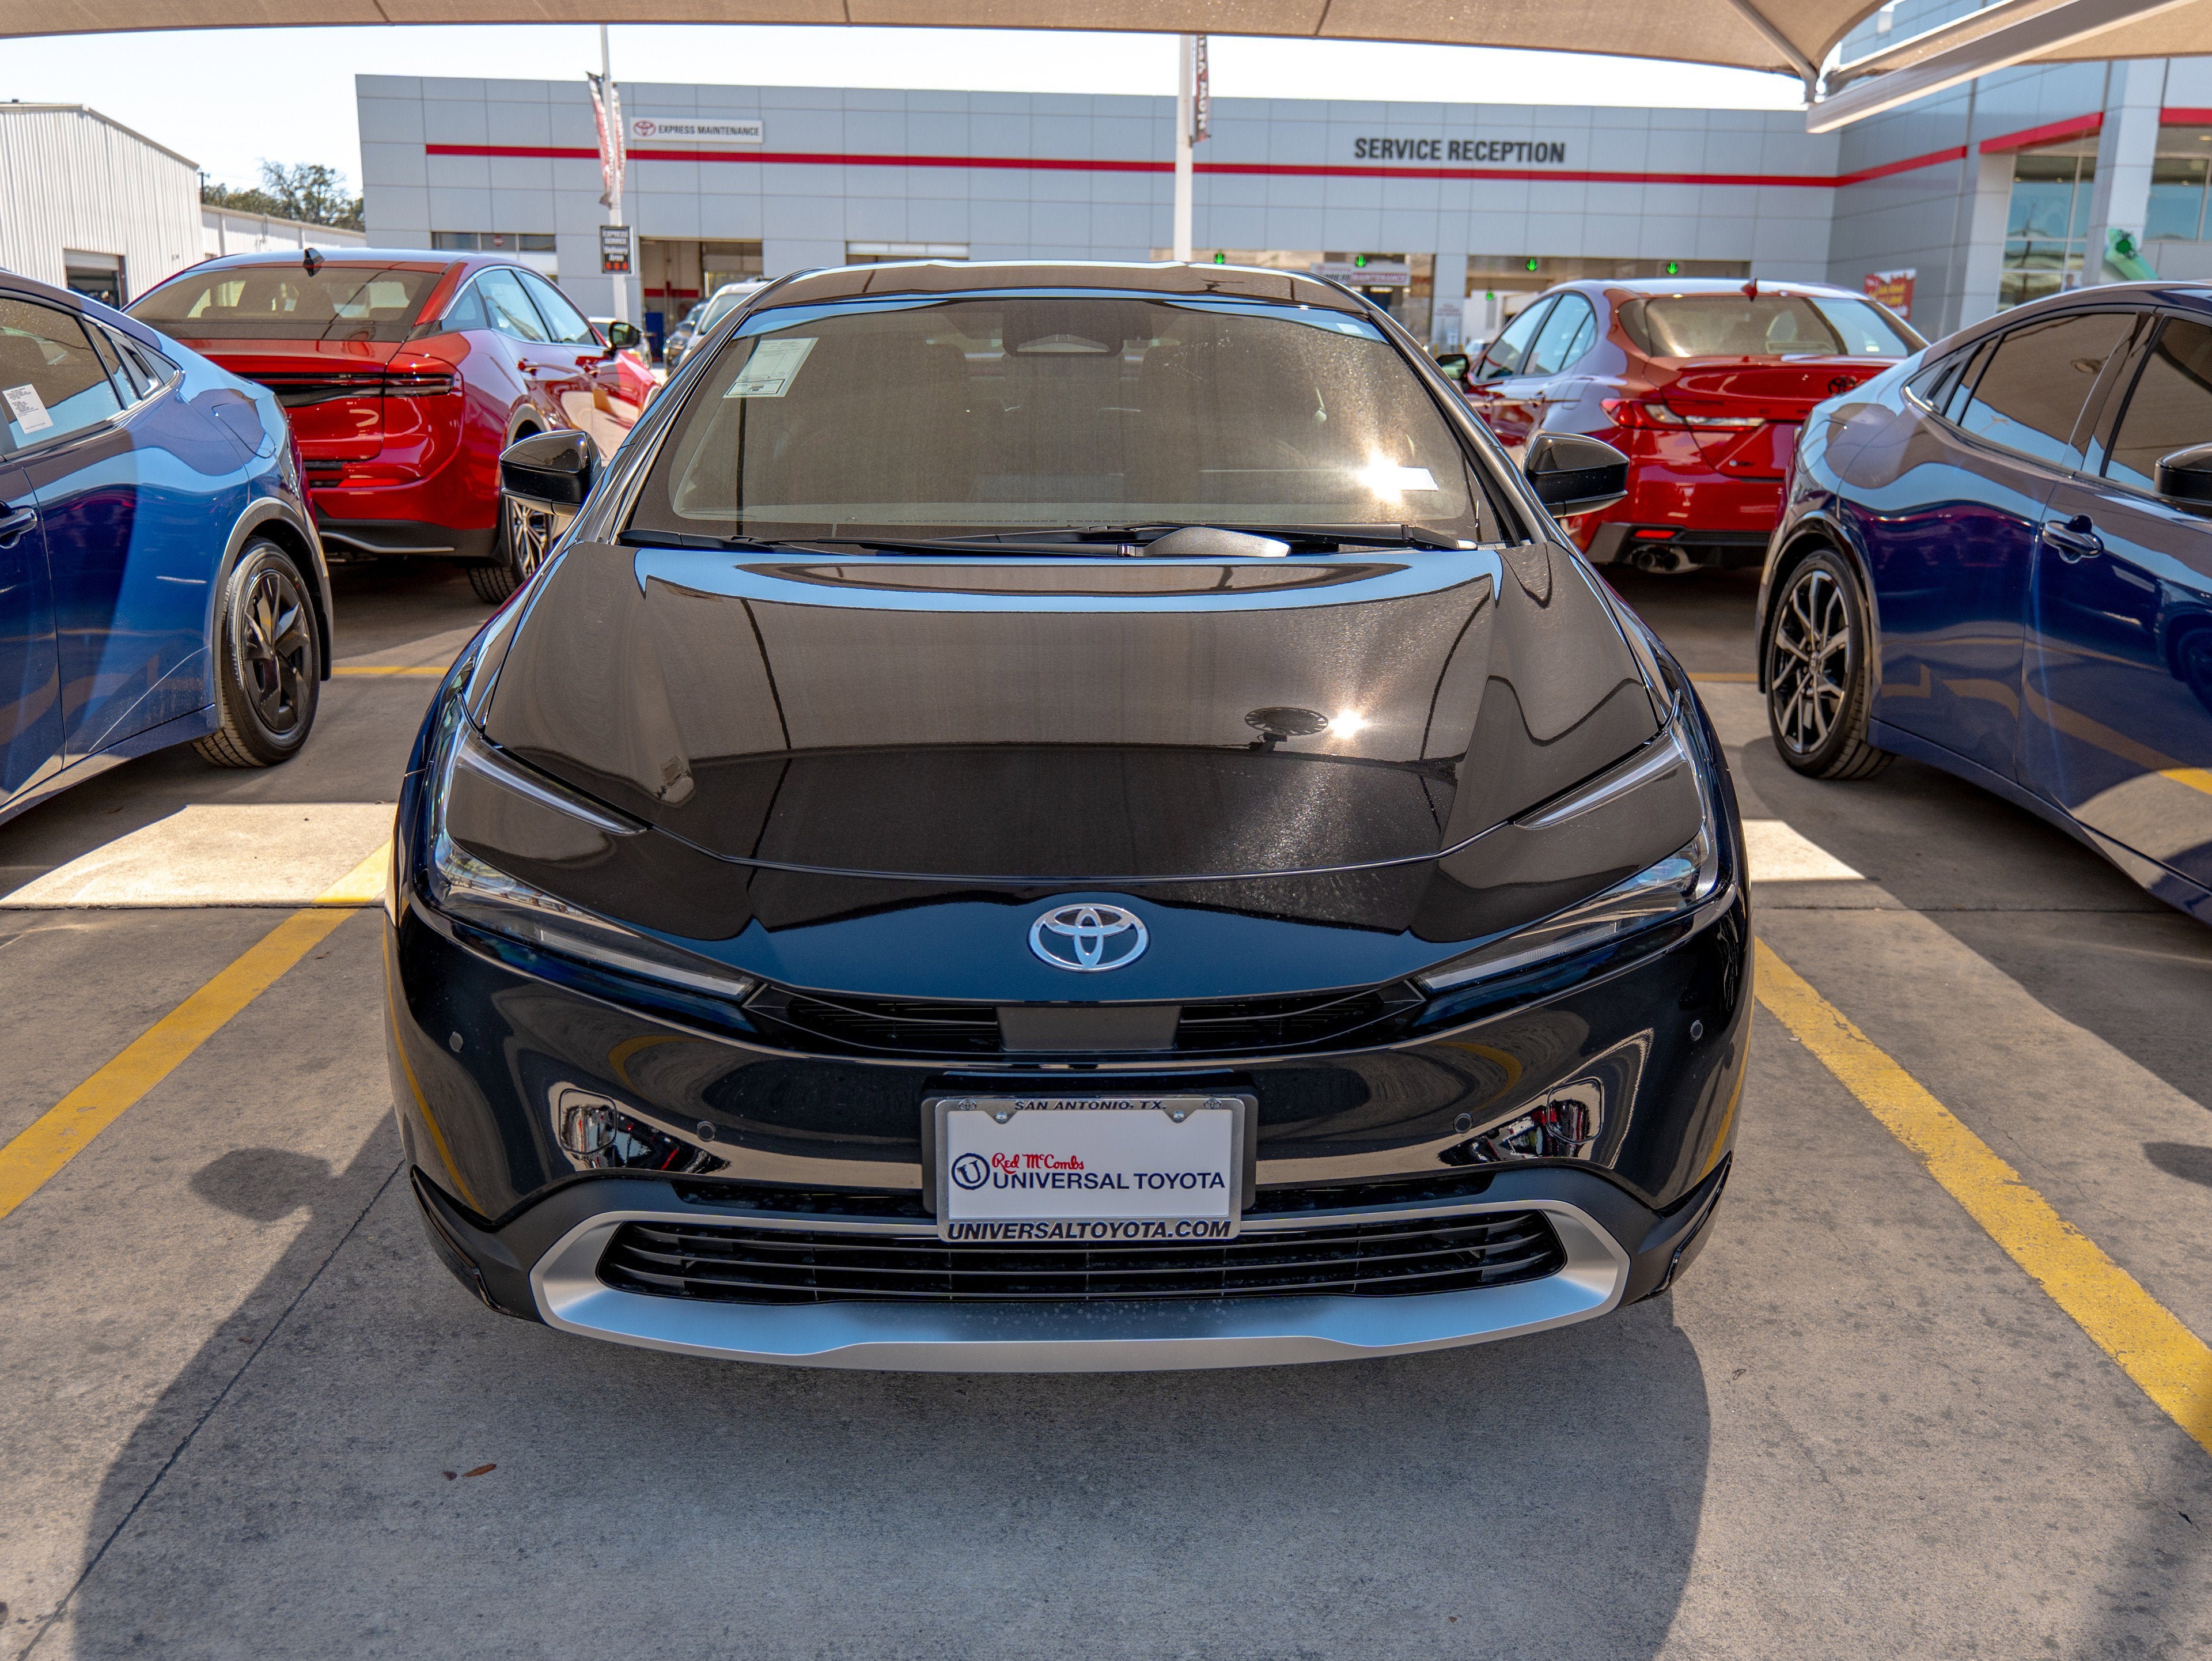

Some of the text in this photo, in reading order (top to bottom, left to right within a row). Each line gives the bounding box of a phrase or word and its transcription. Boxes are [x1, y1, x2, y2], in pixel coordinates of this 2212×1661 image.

[658, 124, 759, 136] EXPRESS MAINTENANCE
[1354, 138, 1566, 162] SERVICE RECEPTION
[1014, 1100, 1167, 1110] SAN ANTONIO, TX.
[992, 1153, 1084, 1174] Red McCombs
[993, 1172, 1225, 1190] UNIVERSAL TOYOTA
[948, 1220, 1232, 1240] UNIVERSALTOYOTA.COM
